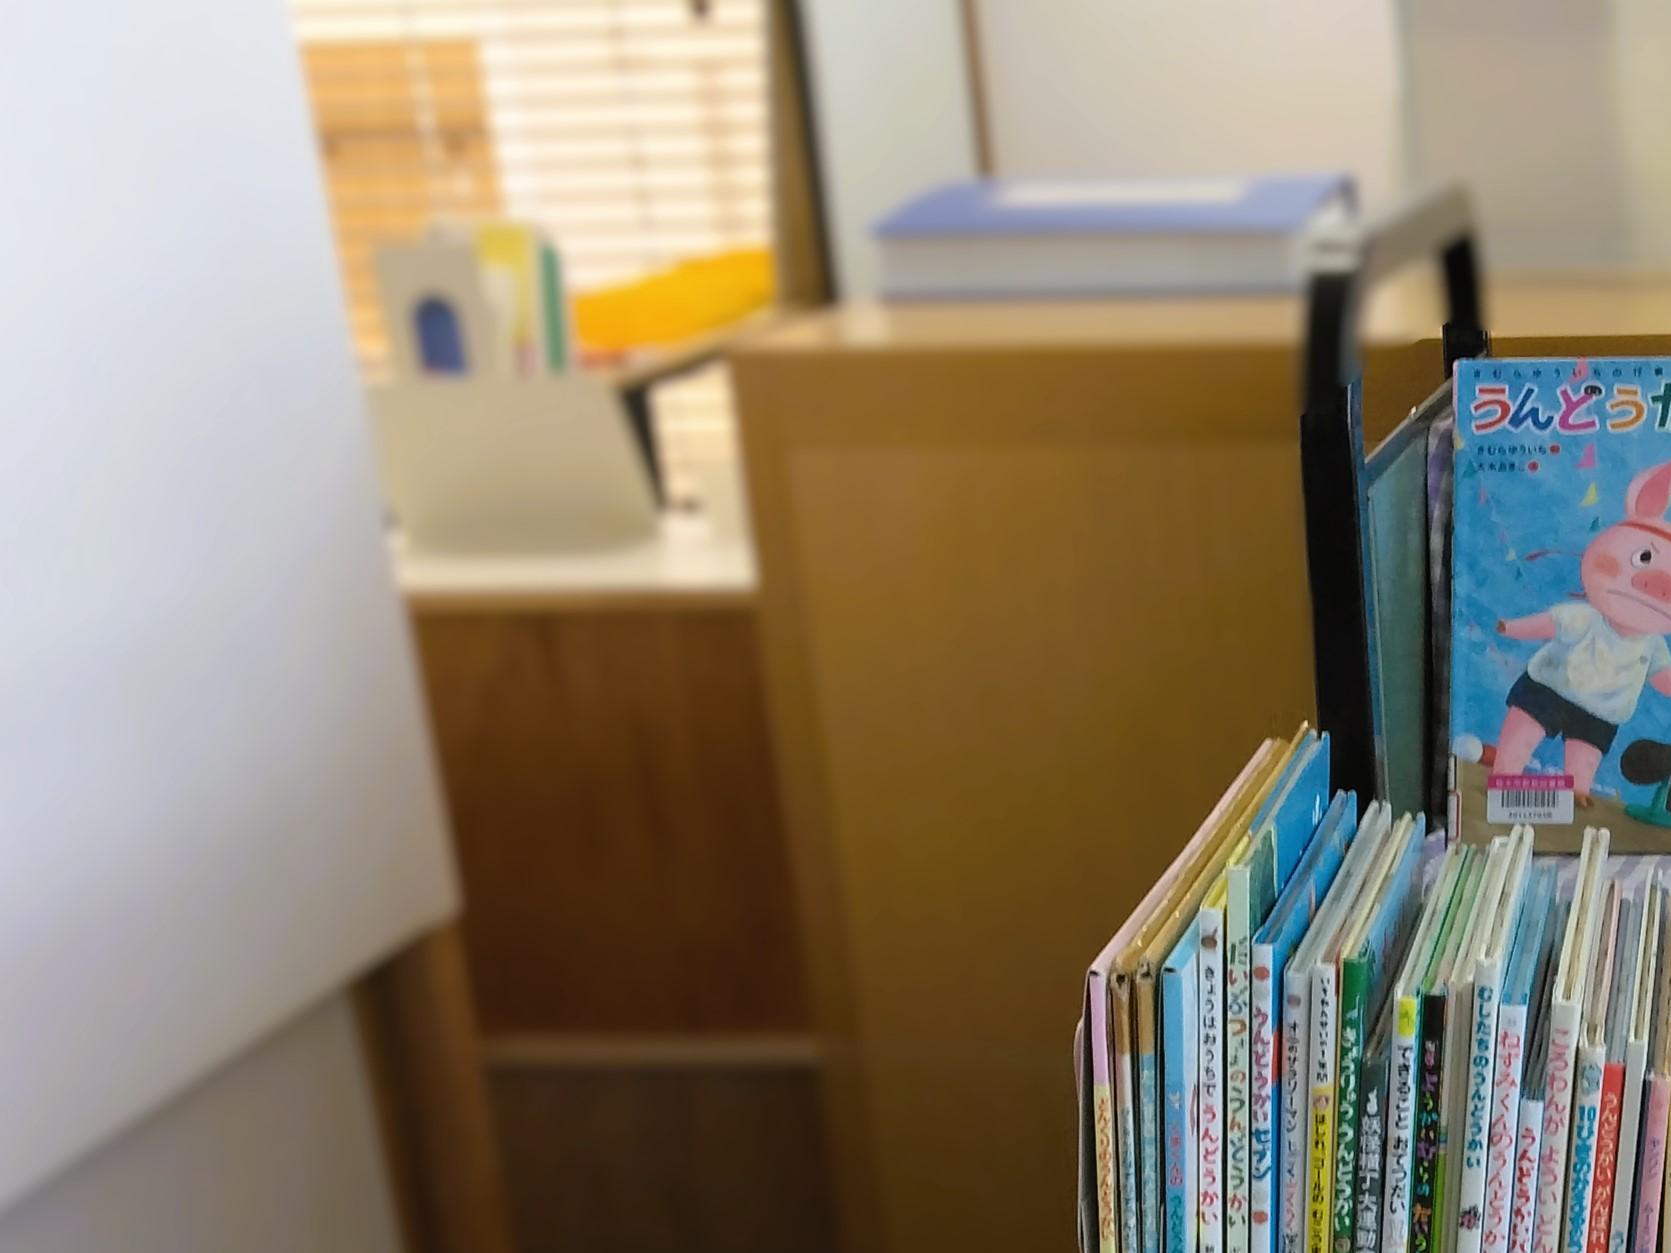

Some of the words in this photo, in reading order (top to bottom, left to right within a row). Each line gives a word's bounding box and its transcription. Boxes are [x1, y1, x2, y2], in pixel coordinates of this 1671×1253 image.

[1202, 966, 1218, 1097] きょうはおうちで
[1467, 986, 1494, 1169] むしたちのうんどうかい
[1201, 1103, 1219, 1226] うんどうかい
